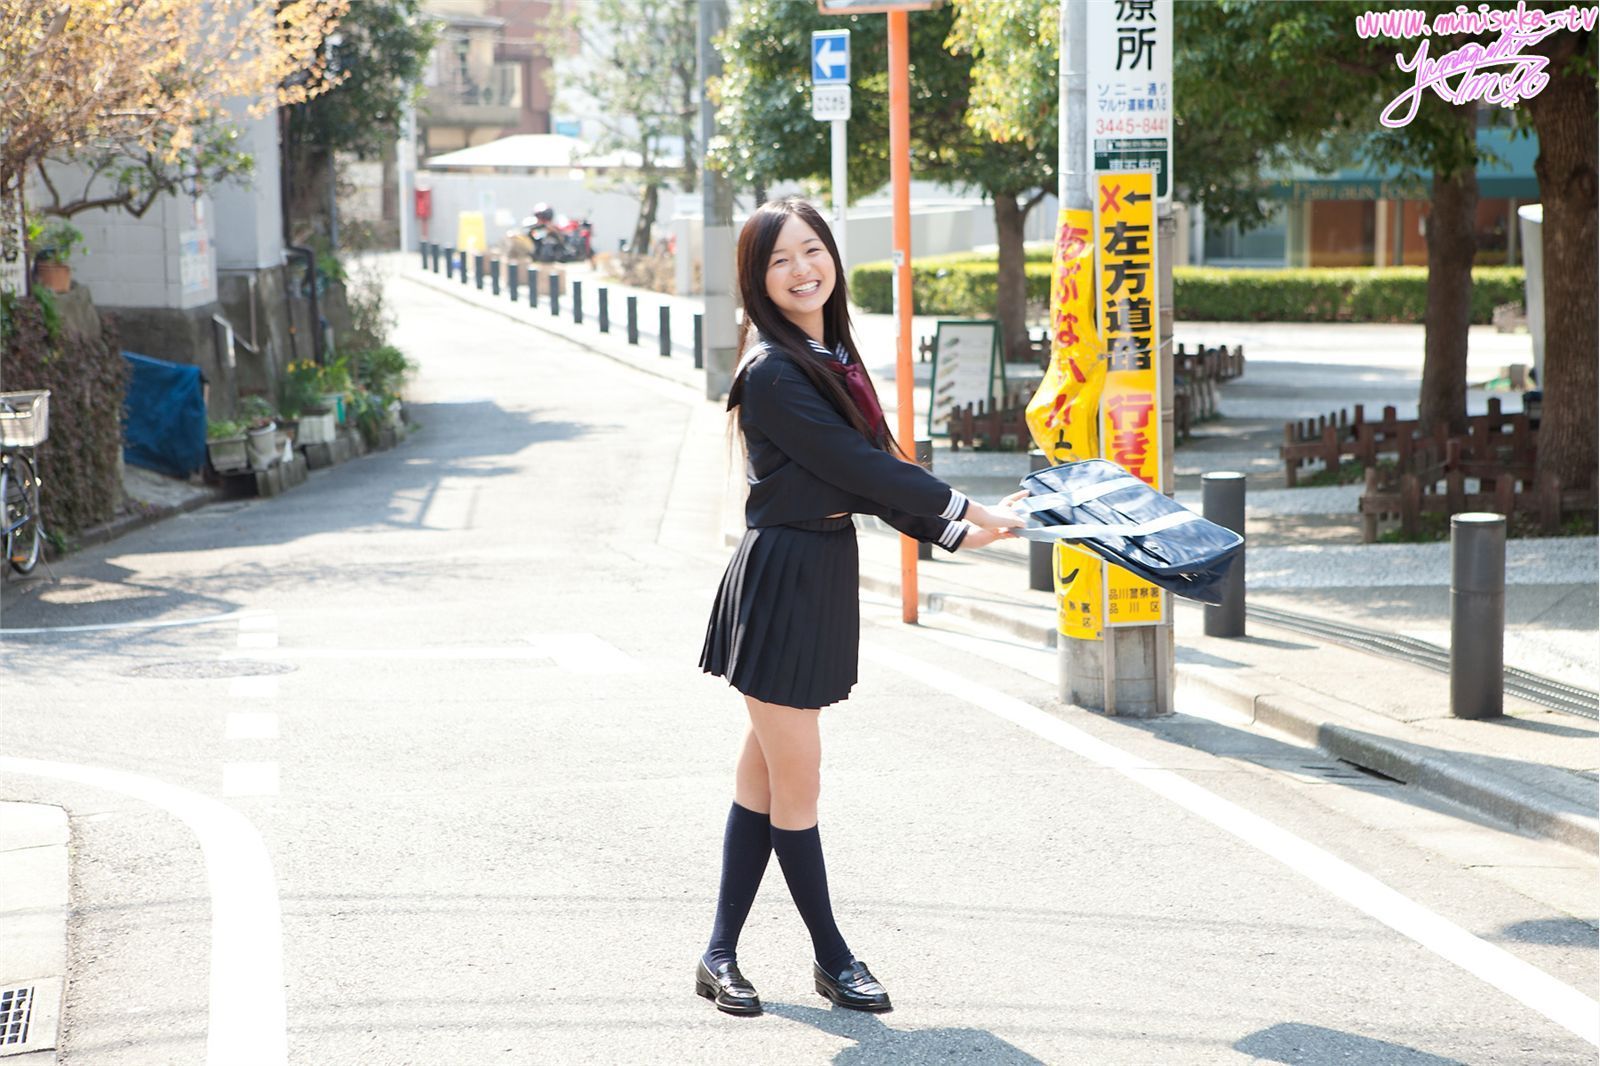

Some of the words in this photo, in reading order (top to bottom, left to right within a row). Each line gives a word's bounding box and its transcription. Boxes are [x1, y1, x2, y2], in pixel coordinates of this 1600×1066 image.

[1104, 221, 1151, 371] 左方道路
[1109, 587, 1159, 600] 品川警察署
